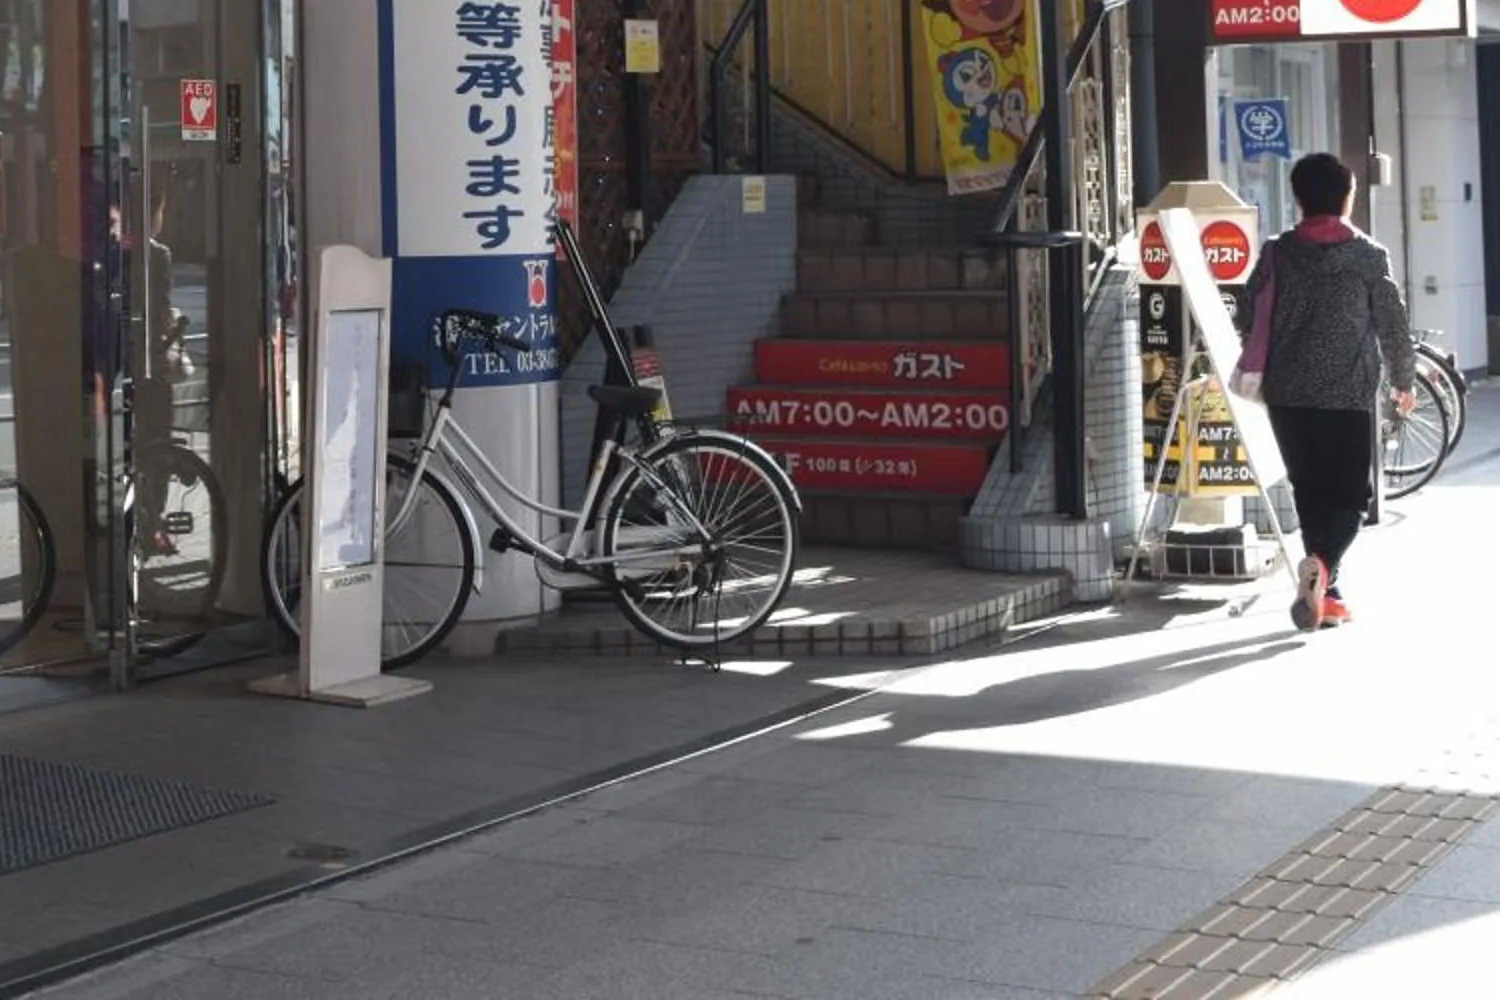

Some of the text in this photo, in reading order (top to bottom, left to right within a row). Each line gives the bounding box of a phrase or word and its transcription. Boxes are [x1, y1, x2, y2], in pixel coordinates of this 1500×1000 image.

[1215, 5, 1300, 25] AM2:00
[185, 83, 213, 96] AED
[465, 352, 511, 376] TEL
[894, 352, 965, 379] ガスト
